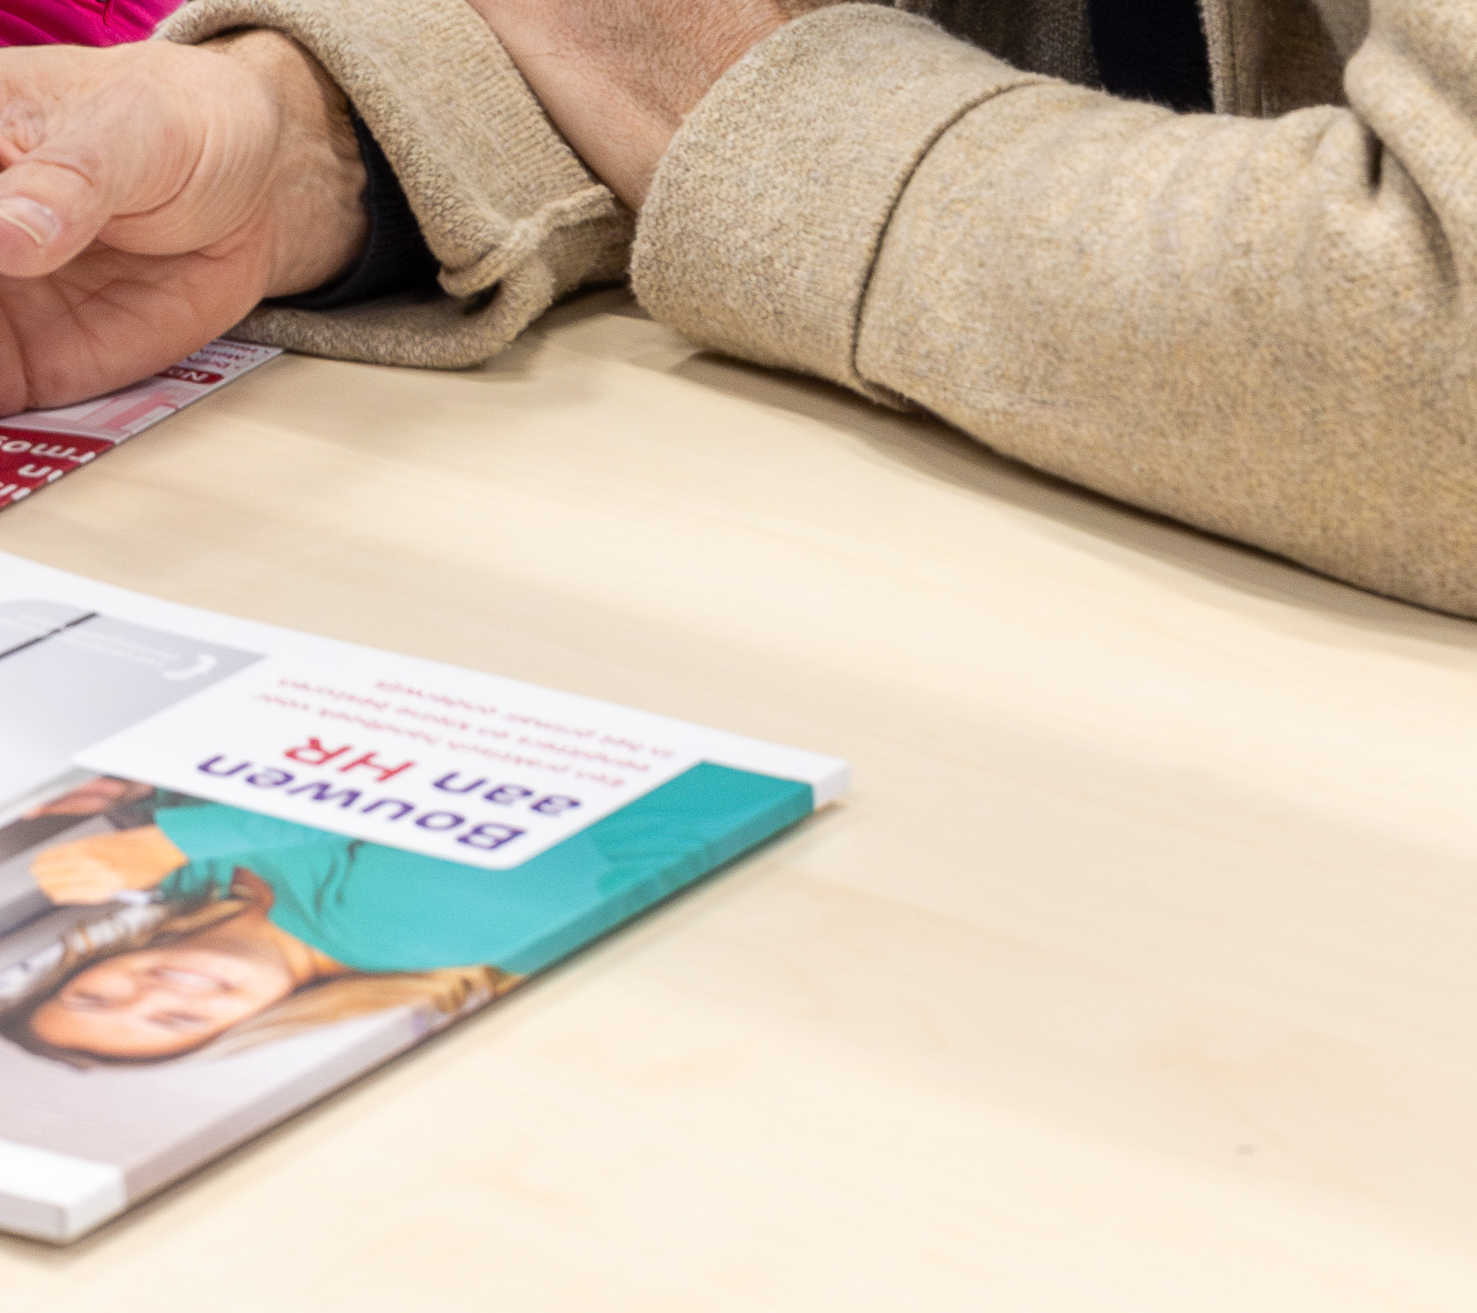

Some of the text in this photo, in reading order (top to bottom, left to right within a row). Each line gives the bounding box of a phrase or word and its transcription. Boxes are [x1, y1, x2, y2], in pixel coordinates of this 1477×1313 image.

[197, 752, 527, 852] Bouwen
[282, 735, 581, 819] aan HR
